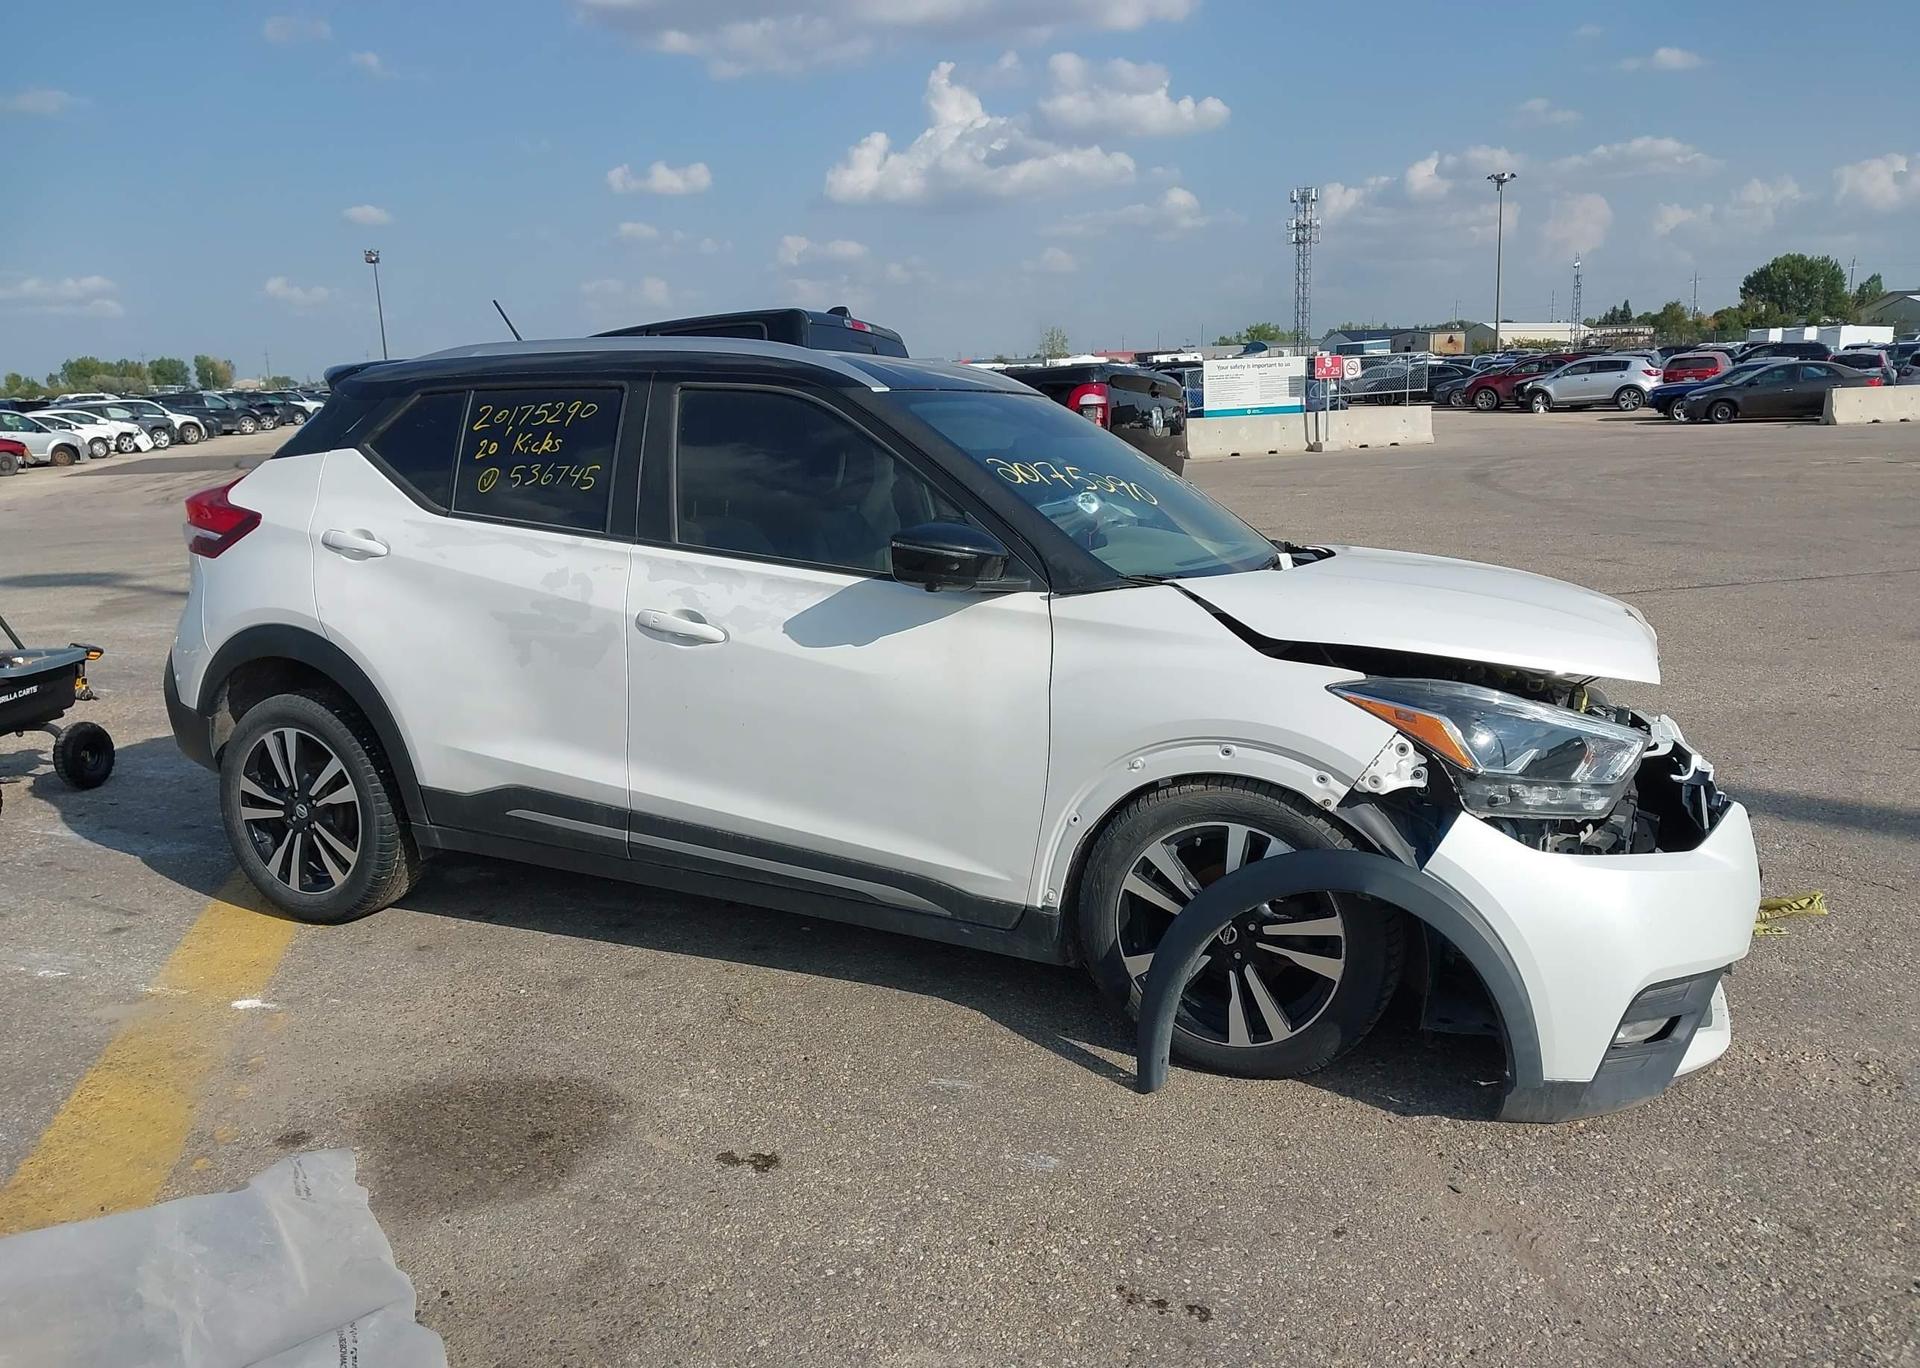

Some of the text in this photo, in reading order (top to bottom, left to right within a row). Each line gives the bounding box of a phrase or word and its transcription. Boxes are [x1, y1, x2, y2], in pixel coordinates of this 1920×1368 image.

[1317, 366, 1340, 376] 24 25
[1324, 357, 1333, 367] S
[473, 401, 598, 433] 20175290
[475, 432, 563, 459] 20 Kicks
[510, 463, 600, 490] 536745
[18, 685, 39, 698] CARTS
